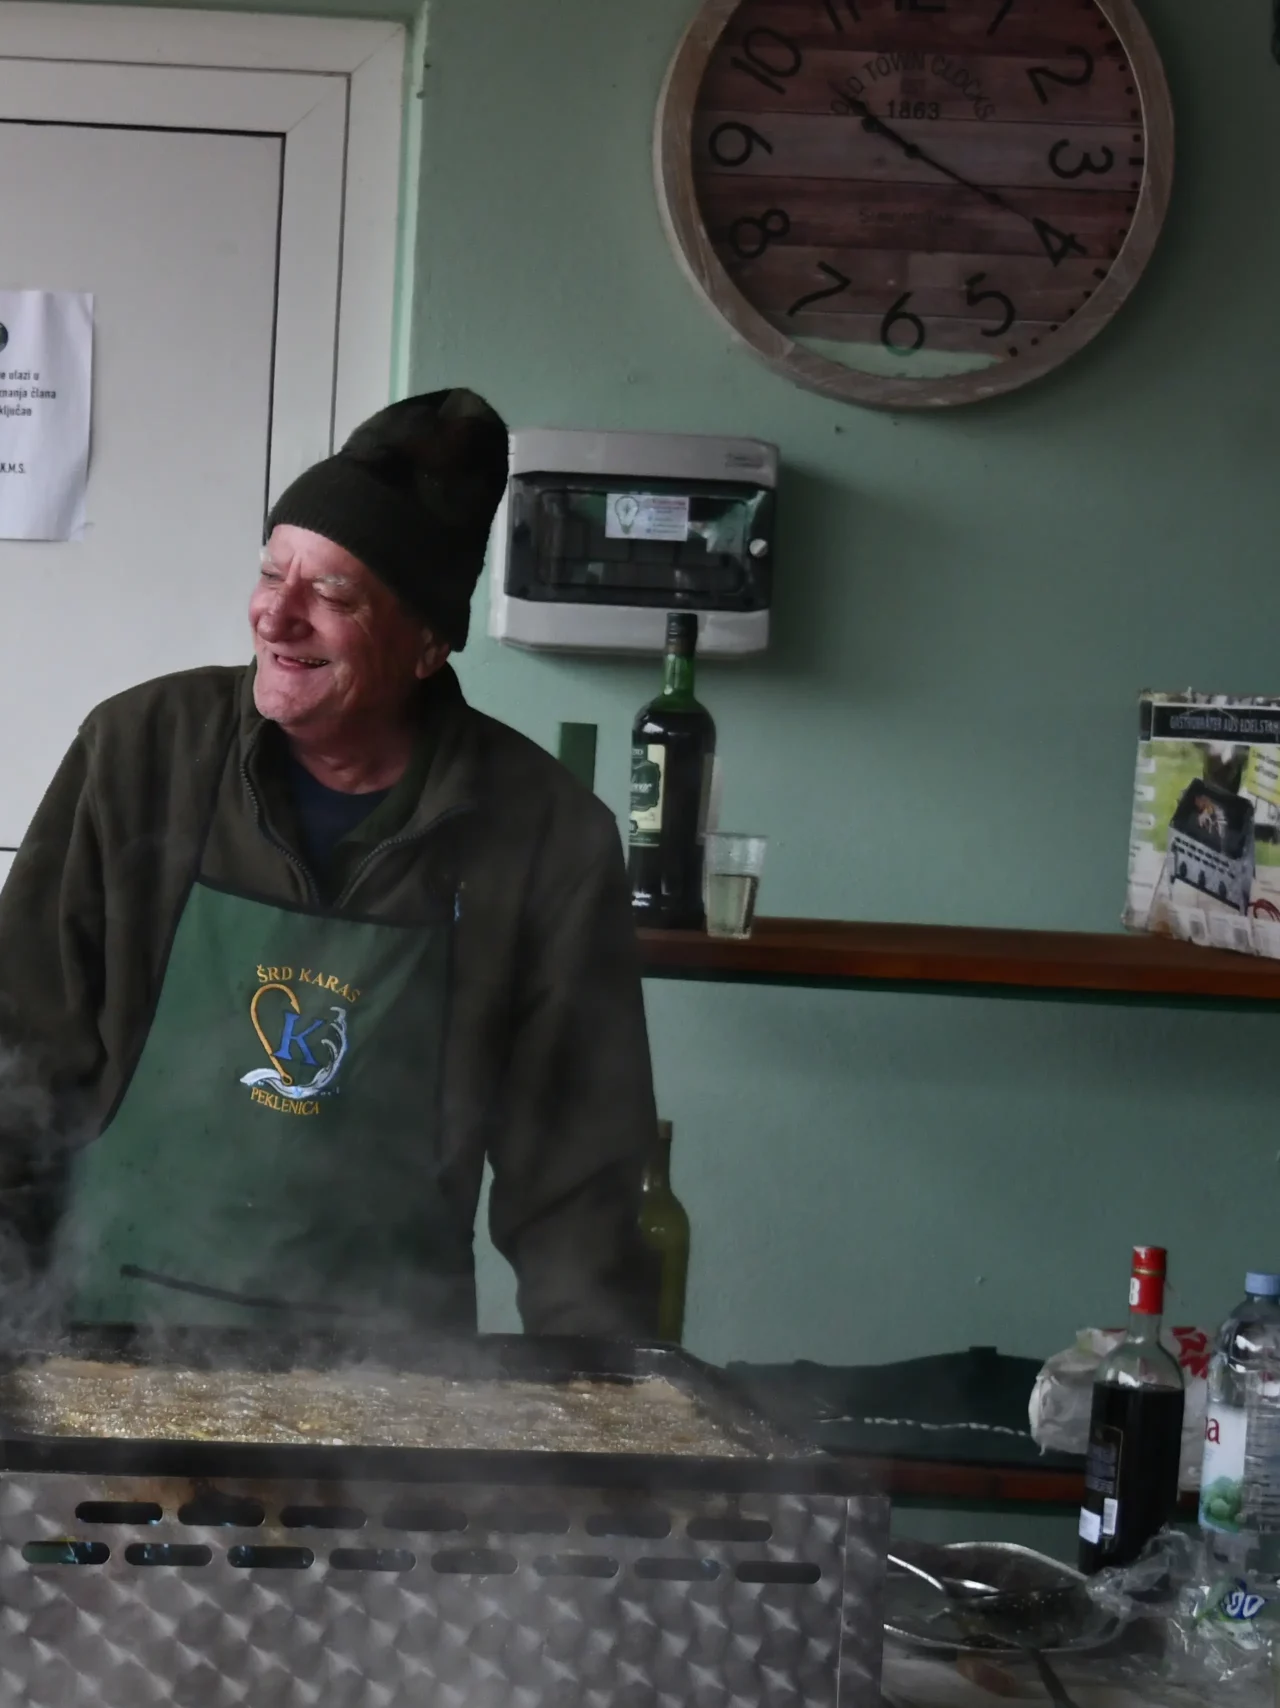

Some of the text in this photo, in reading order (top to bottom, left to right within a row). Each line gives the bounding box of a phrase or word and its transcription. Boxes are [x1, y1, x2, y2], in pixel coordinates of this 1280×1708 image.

[731, 25, 802, 94] 10
[1026, 45, 1094, 104] 2
[831, 51, 997, 121] OD TOWN CLOCKS
[887, 100, 940, 120] 1863
[708, 121, 774, 168] 9
[1048, 139, 1115, 179] 3
[728, 208, 790, 259] 8
[1032, 217, 1088, 267] 4
[788, 262, 852, 317] 7
[965, 272, 1016, 337] 5
[880, 292, 925, 357] 6
[9, 370, 30, 380] ulazi
[33, 372, 40, 381] u
[31, 386, 57, 399] člana
[256, 964, 362, 1003] ŠRD KARAS
[273, 1012, 324, 1066] K
[250, 1087, 320, 1115] PEKLENICA
